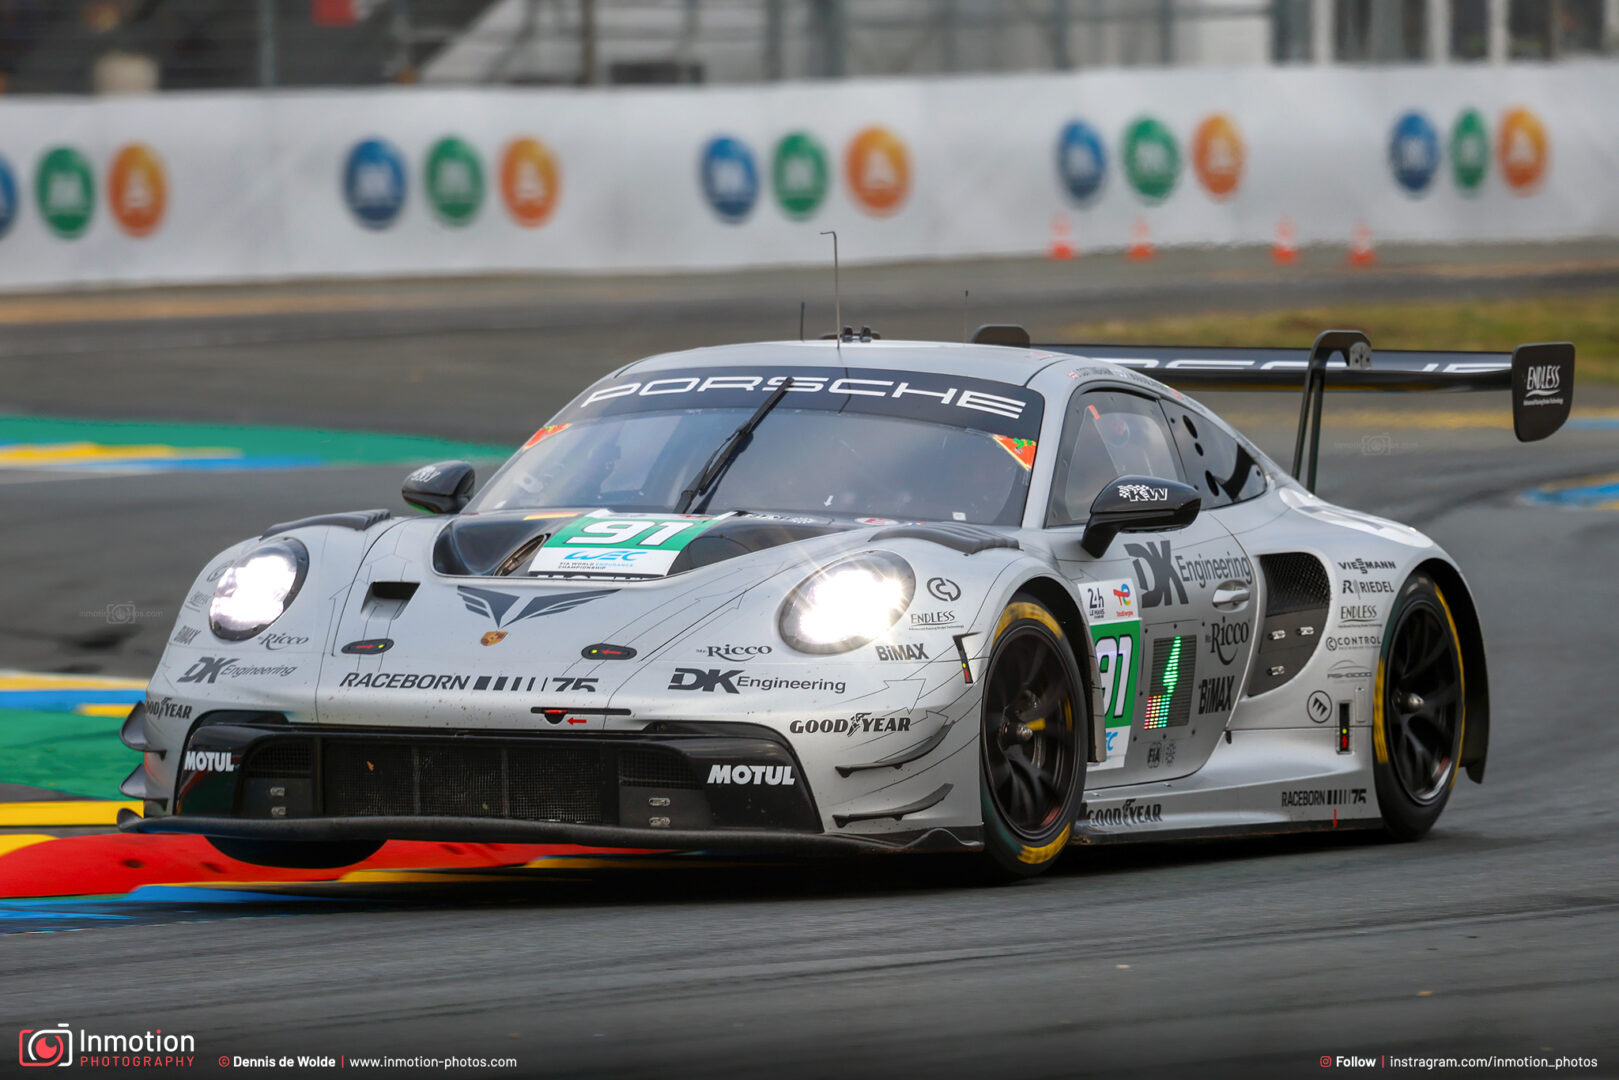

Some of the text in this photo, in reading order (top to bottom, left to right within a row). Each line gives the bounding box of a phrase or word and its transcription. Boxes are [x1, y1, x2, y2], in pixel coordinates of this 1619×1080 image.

[1526, 364, 1561, 390] ENDLESS
[580, 375, 1027, 420] PORSCHE
[565, 519, 696, 547] 91
[564, 550, 648, 561] WEC
[1123, 540, 1253, 609] DK Engineering
[1359, 580, 1395, 594] RIEDEL
[911, 610, 956, 624] ENDLESS
[1340, 605, 1377, 620] ENDLESS
[259, 632, 309, 651] Ricco
[1338, 635, 1382, 646] CONTROL
[707, 644, 773, 662] Ricco
[875, 642, 930, 662] BiMAX
[176, 656, 298, 684] DK Engineering
[1095, 633, 1133, 719] 91
[339, 672, 599, 692] RACEBORN 75
[667, 667, 847, 694] DK Engineering
[184, 751, 235, 773] MOTUL
[707, 763, 796, 786] MOTUL
[1281, 789, 1326, 808] RACEBORN
